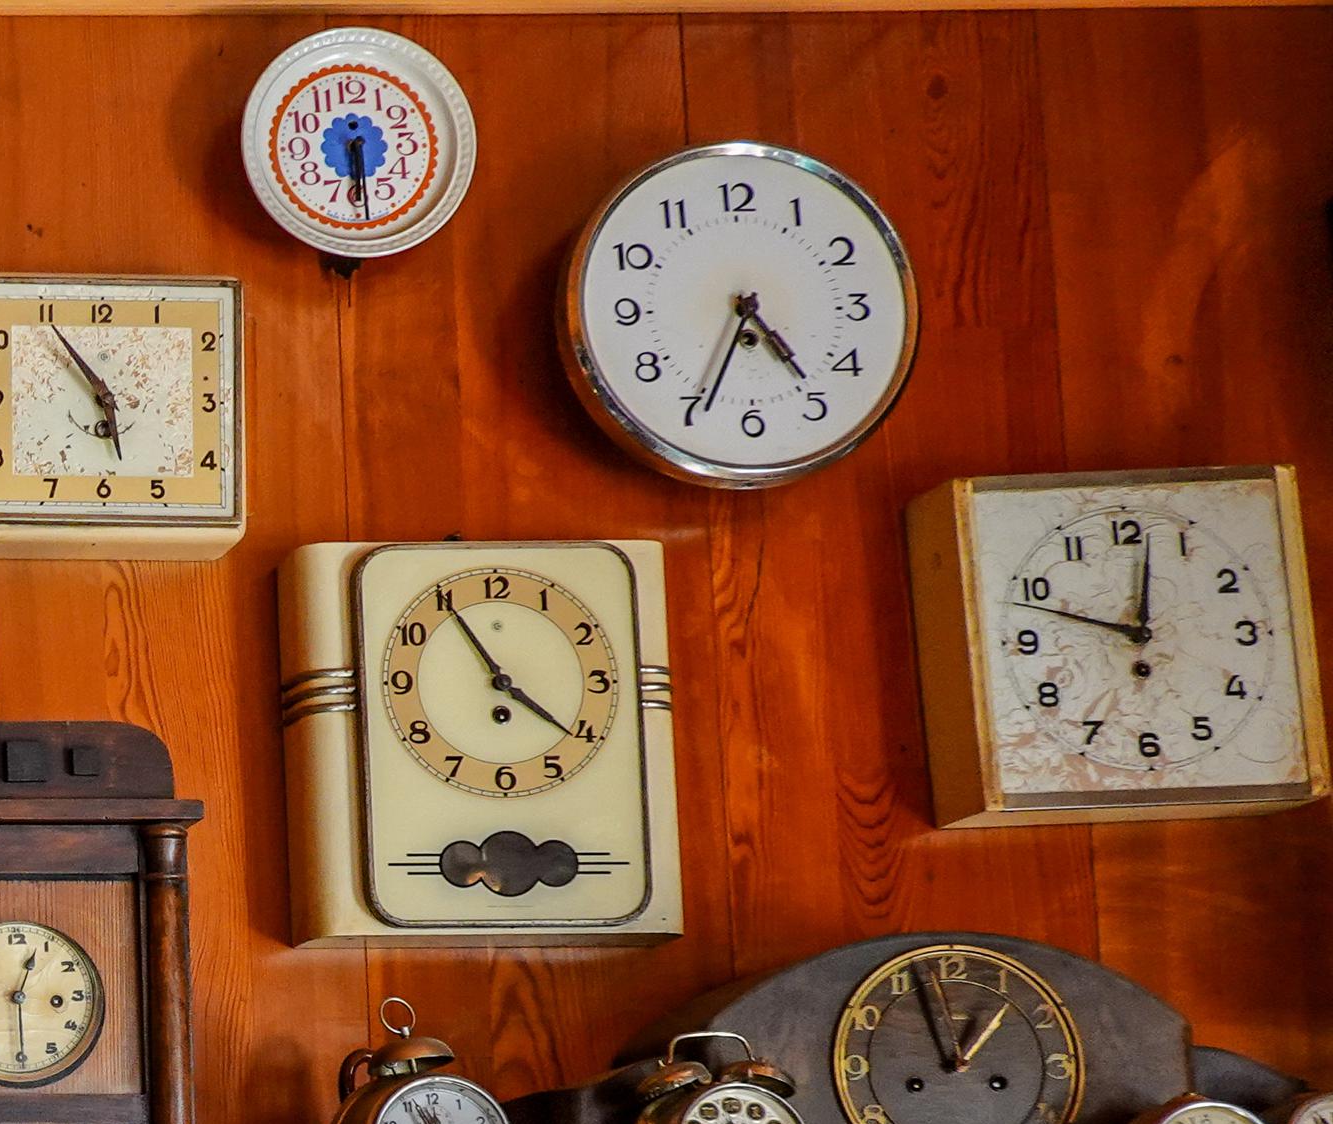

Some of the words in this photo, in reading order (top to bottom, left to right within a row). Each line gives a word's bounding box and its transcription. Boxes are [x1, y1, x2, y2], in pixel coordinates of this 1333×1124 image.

[313, 89, 331, 113] 11
[337, 80, 366, 104] 12
[293, 111, 320, 133] 10
[386, 105, 407, 129] 2
[288, 136, 310, 161] 9
[396, 132, 418, 156] 3
[300, 162, 321, 185] 8
[324, 179, 342, 203] 7
[717, 182, 757, 213] 12
[659, 199, 686, 229] 11
[612, 242, 653, 271] 10
[828, 236, 856, 266] 2
[39, 304, 53, 322] 11
[91, 304, 113, 323] 12
[614, 297, 641, 326] 9
[846, 293, 871, 321] 3
[201, 332, 216, 352] 2
[635, 351, 661, 382] 8
[802, 392, 828, 421] 5
[741, 409, 766, 438] 6
[43, 478, 58, 498] 7
[150, 479, 165, 499] 5
[1111, 520, 1142, 545] 12
[483, 575, 511, 599] 12
[1023, 577, 1050, 601] 10
[1217, 568, 1240, 593] 2
[401, 622, 427, 646] 10
[574, 622, 594, 645] 2
[1017, 629, 1040, 655] 9
[1235, 621, 1258, 646] 3
[391, 671, 413, 695] 9
[587, 670, 610, 694] 3
[1037, 682, 1059, 707] 8
[409, 721, 431, 744] 8
[444, 756, 464, 778] 7
[495, 766, 517, 791] 6
[8, 934, 27, 945] 12
[45, 1043, 58, 1054] 5
[426, 1093, 439, 1105] 12
